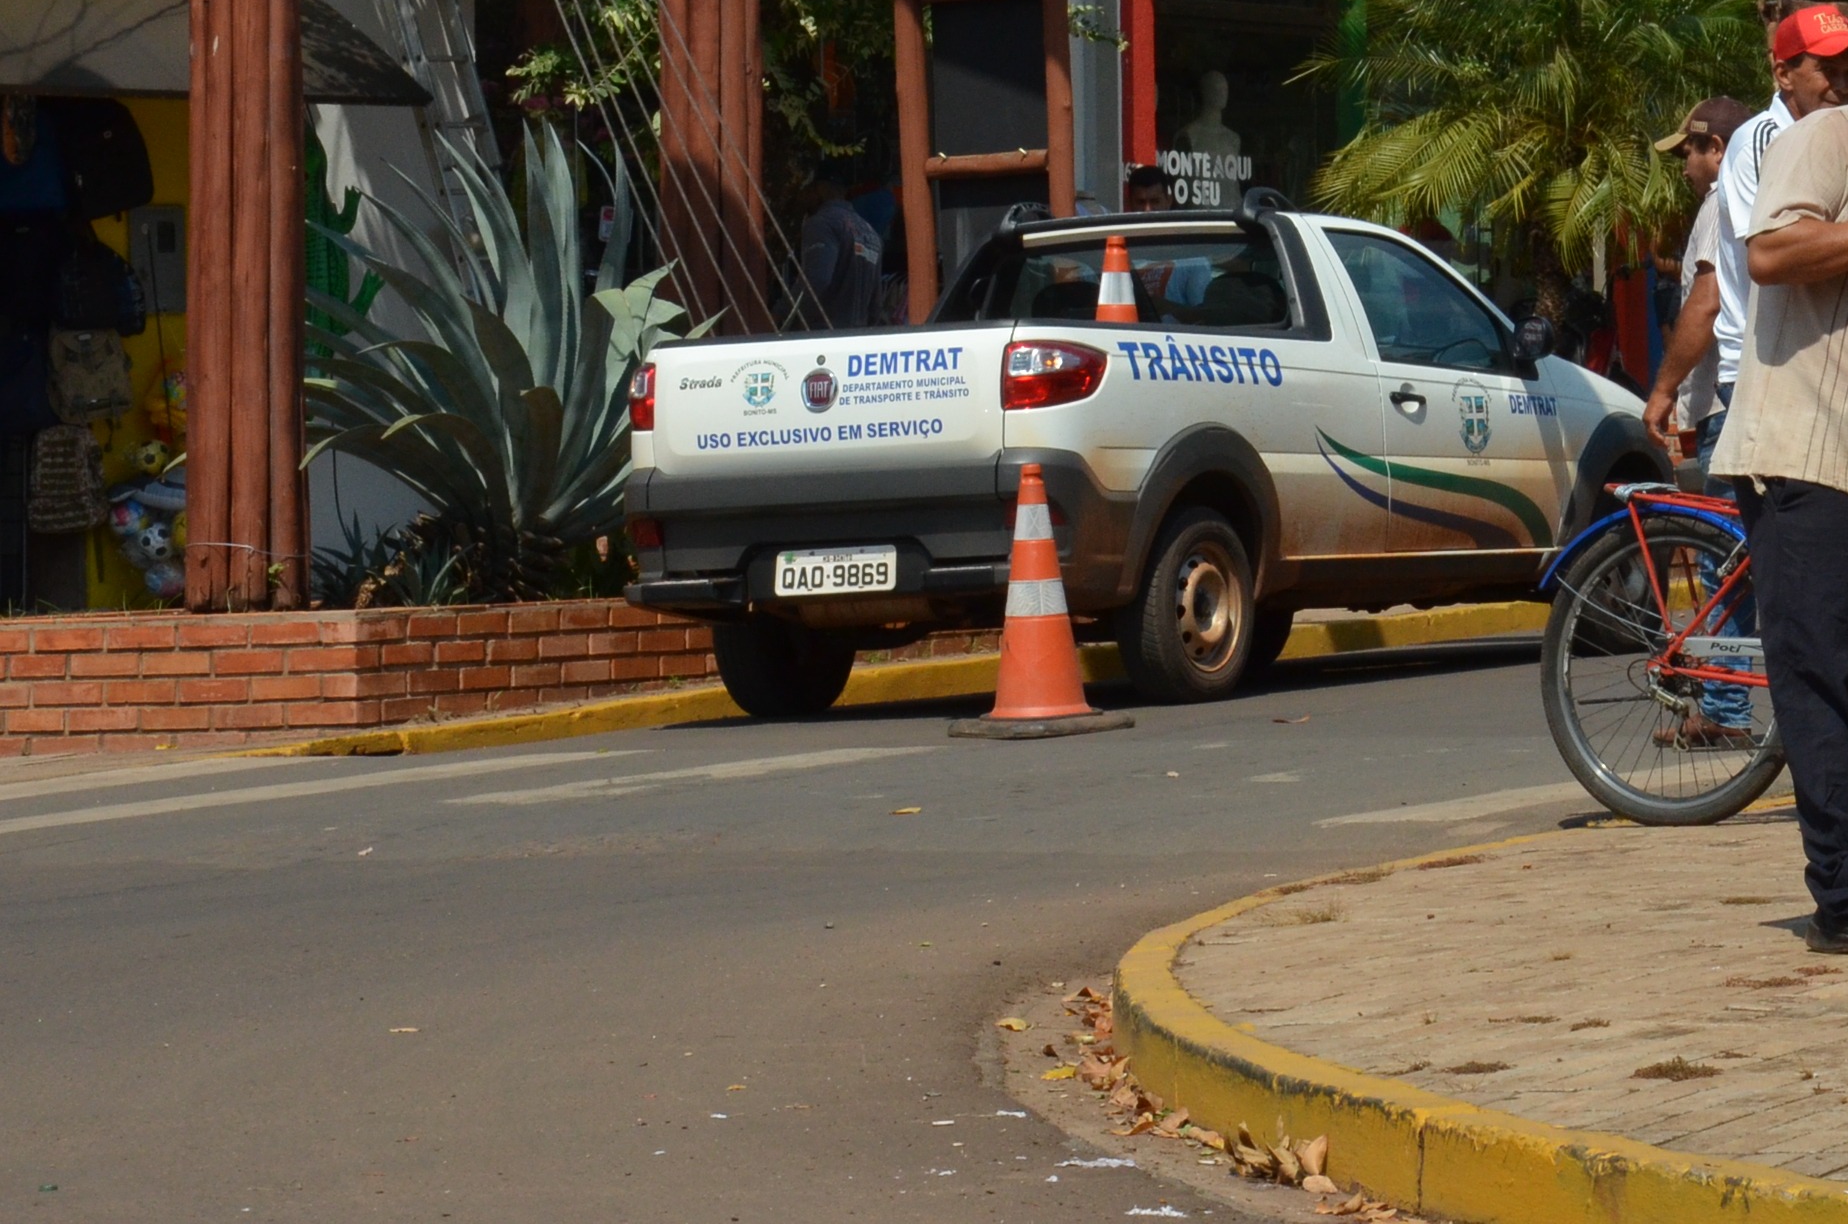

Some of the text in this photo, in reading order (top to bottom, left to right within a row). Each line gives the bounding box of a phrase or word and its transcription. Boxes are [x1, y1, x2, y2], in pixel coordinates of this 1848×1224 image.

[1156, 150, 1210, 178] MONTE
[1213, 155, 1252, 181] AQUI
[1192, 180, 1220, 206] SEU
[730, 359, 790, 383] PREFEITURA MUNICIPAL
[847, 347, 963, 377] DEMTRAT
[1117, 334, 1283, 387] TRÂNSITO
[679, 375, 723, 391] Strada
[809, 380, 829, 399] FIAT
[842, 376, 966, 393] DEPARTAMENTO MUNICIPAL
[839, 387, 969, 406] DE TRANSPORTE E TRÂNSITO
[1508, 393, 1558, 416] DEMTRAT
[743, 408, 777, 417] BONITO-MS
[697, 418, 943, 449] USO EXCLUSIVO EM SERVIÇO
